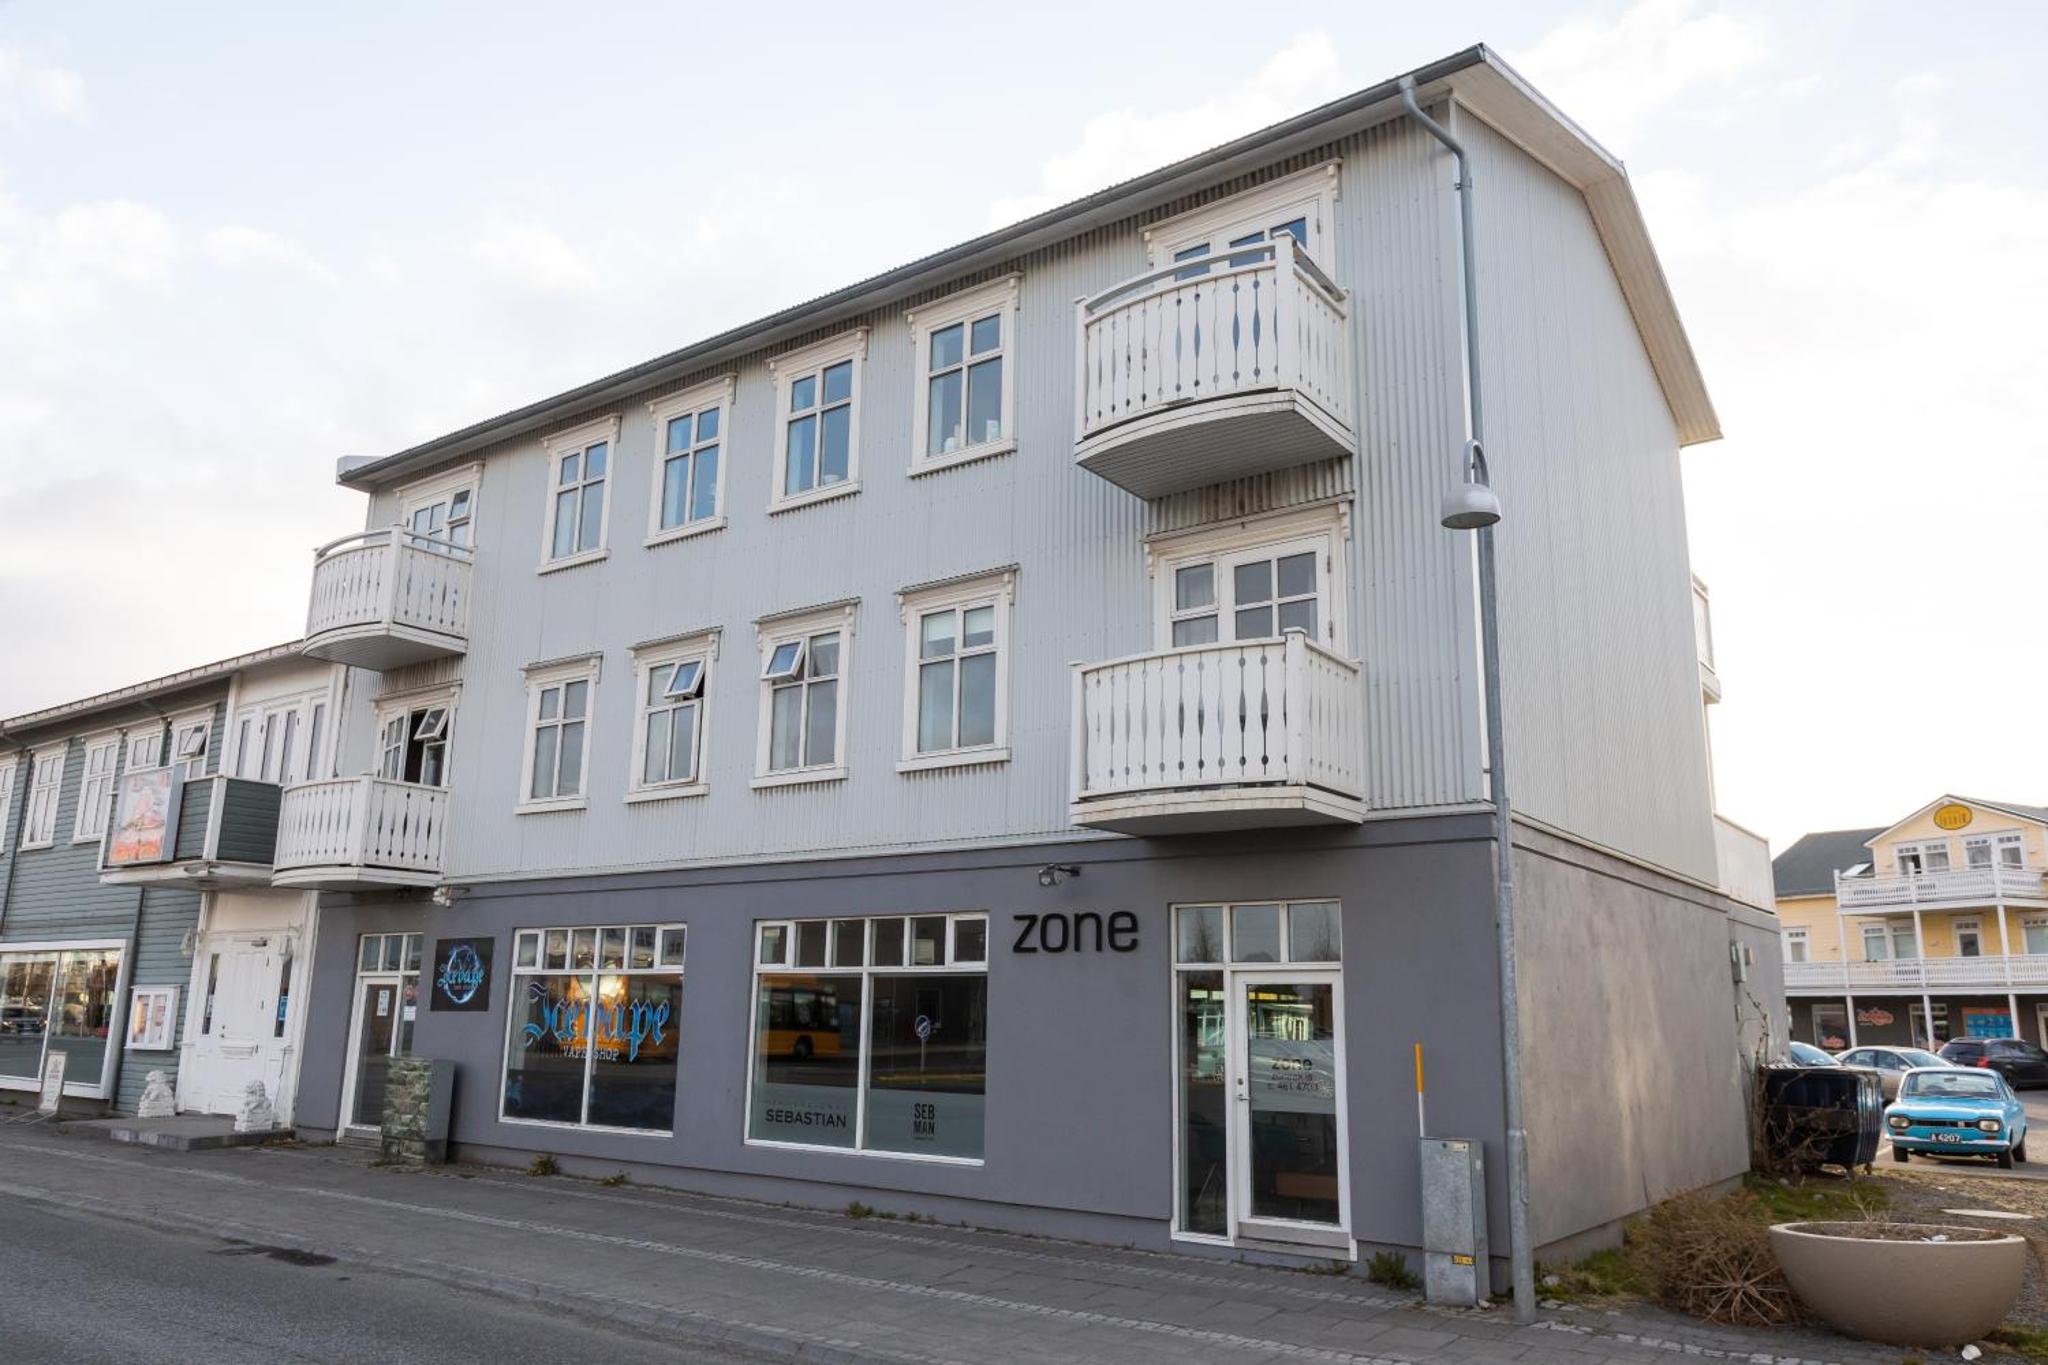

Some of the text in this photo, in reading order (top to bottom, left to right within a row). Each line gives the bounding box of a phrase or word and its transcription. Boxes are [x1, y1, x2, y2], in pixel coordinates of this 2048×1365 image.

[1012, 910, 1139, 954] zone
[593, 1046, 620, 1062] SHOP
[1271, 1057, 1313, 1071] zone
[765, 1108, 847, 1129] SEBASTIAN
[913, 1102, 936, 1121] SEB
[913, 1119, 936, 1137] MAN
